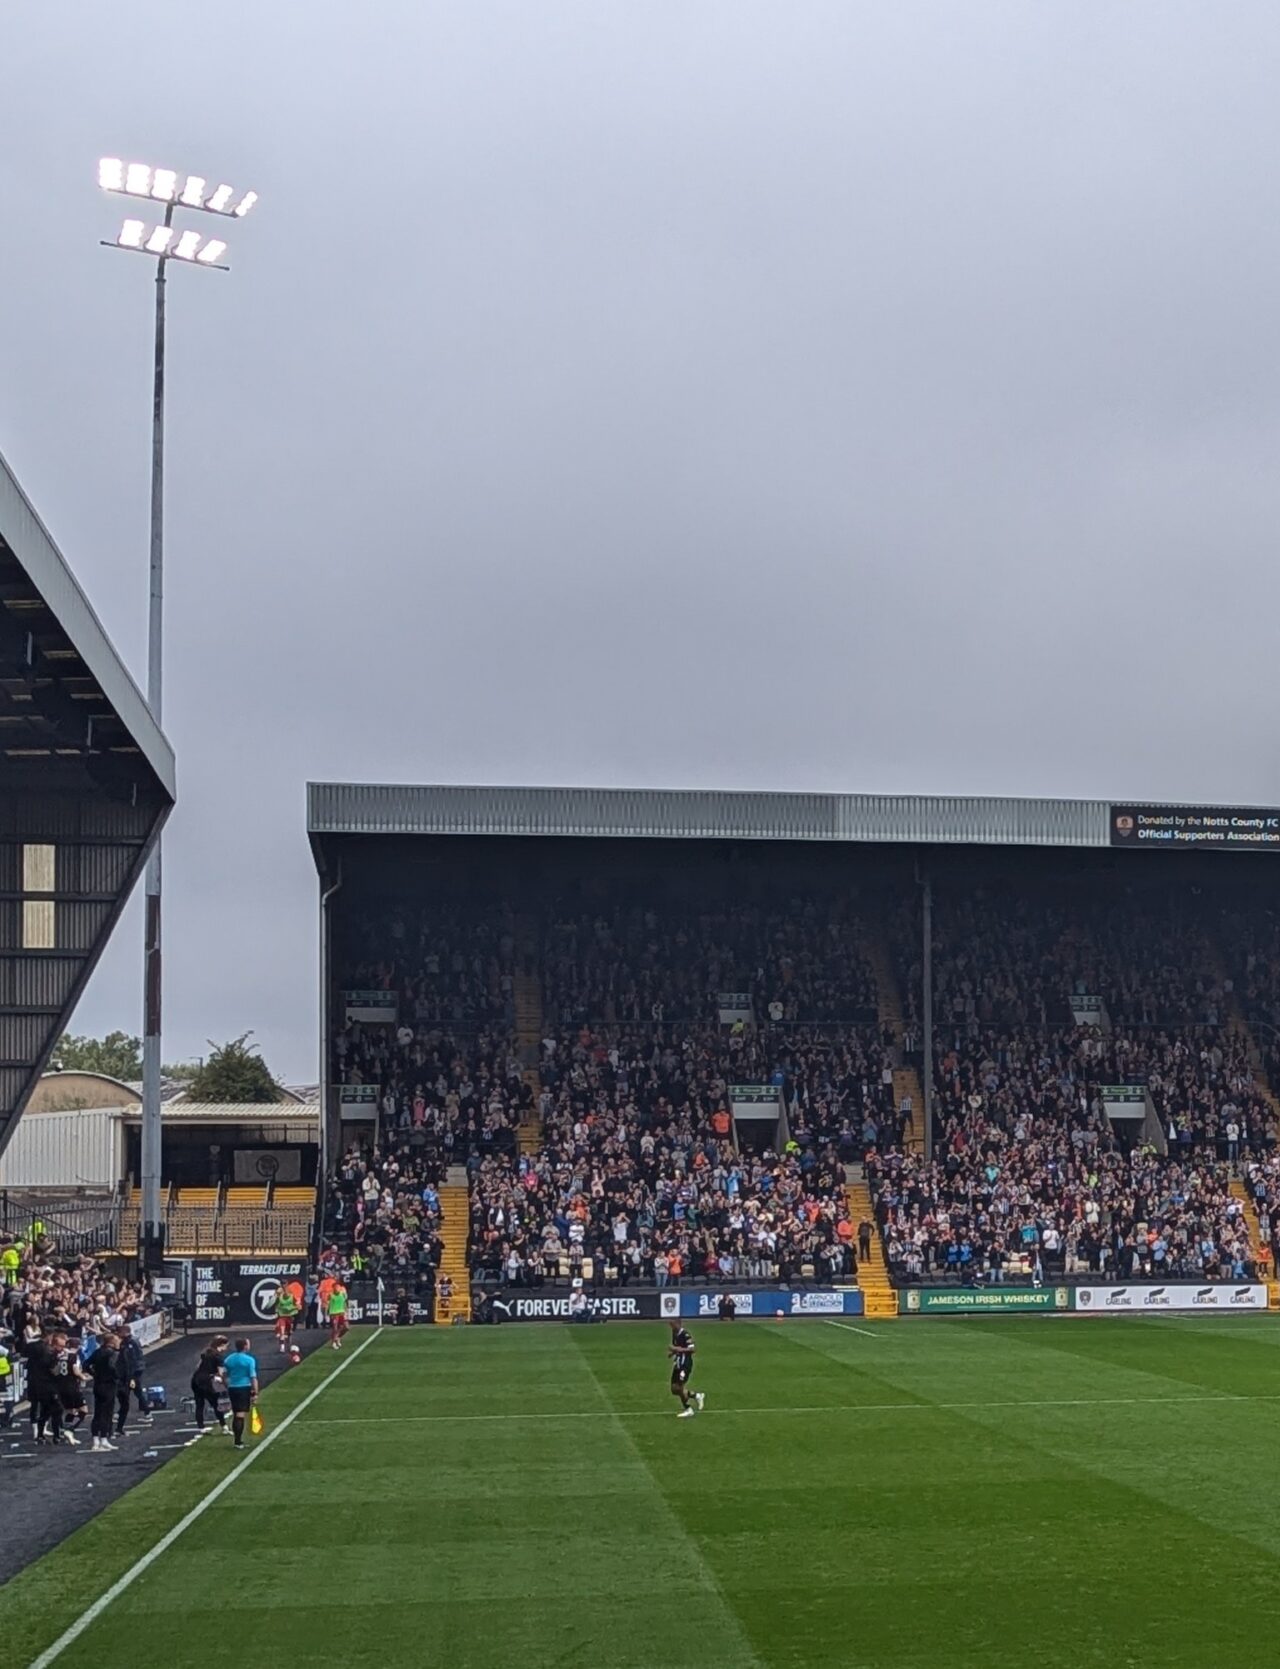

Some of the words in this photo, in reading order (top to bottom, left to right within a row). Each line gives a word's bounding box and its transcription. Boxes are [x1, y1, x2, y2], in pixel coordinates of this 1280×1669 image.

[1138, 815, 1174, 826] Donated
[1175, 816, 1186, 828] by
[1188, 816, 1201, 826] the
[1203, 817, 1229, 826] Notts
[1231, 818, 1264, 829] County
[1267, 819, 1279, 827] FC
[1138, 829, 1171, 839] Official
[1174, 831, 1225, 841] Supporters
[1227, 831, 1280, 841] Association
[196, 1267, 214, 1279] THE
[240, 1264, 300, 1275] TERRACELIFE.CO
[196, 1280, 222, 1292] HOME
[196, 1294, 208, 1306] OF
[928, 1296, 973, 1305] JAMESON
[976, 1295, 1001, 1304] IRISH
[1004, 1294, 1049, 1303] WHISKEY
[1106, 1297, 1132, 1305] CARLING
[1144, 1297, 1170, 1305] CARLING
[1192, 1296, 1218, 1304] CARLING
[1230, 1296, 1256, 1304] CARLING
[196, 1307, 225, 1320] RETRO
